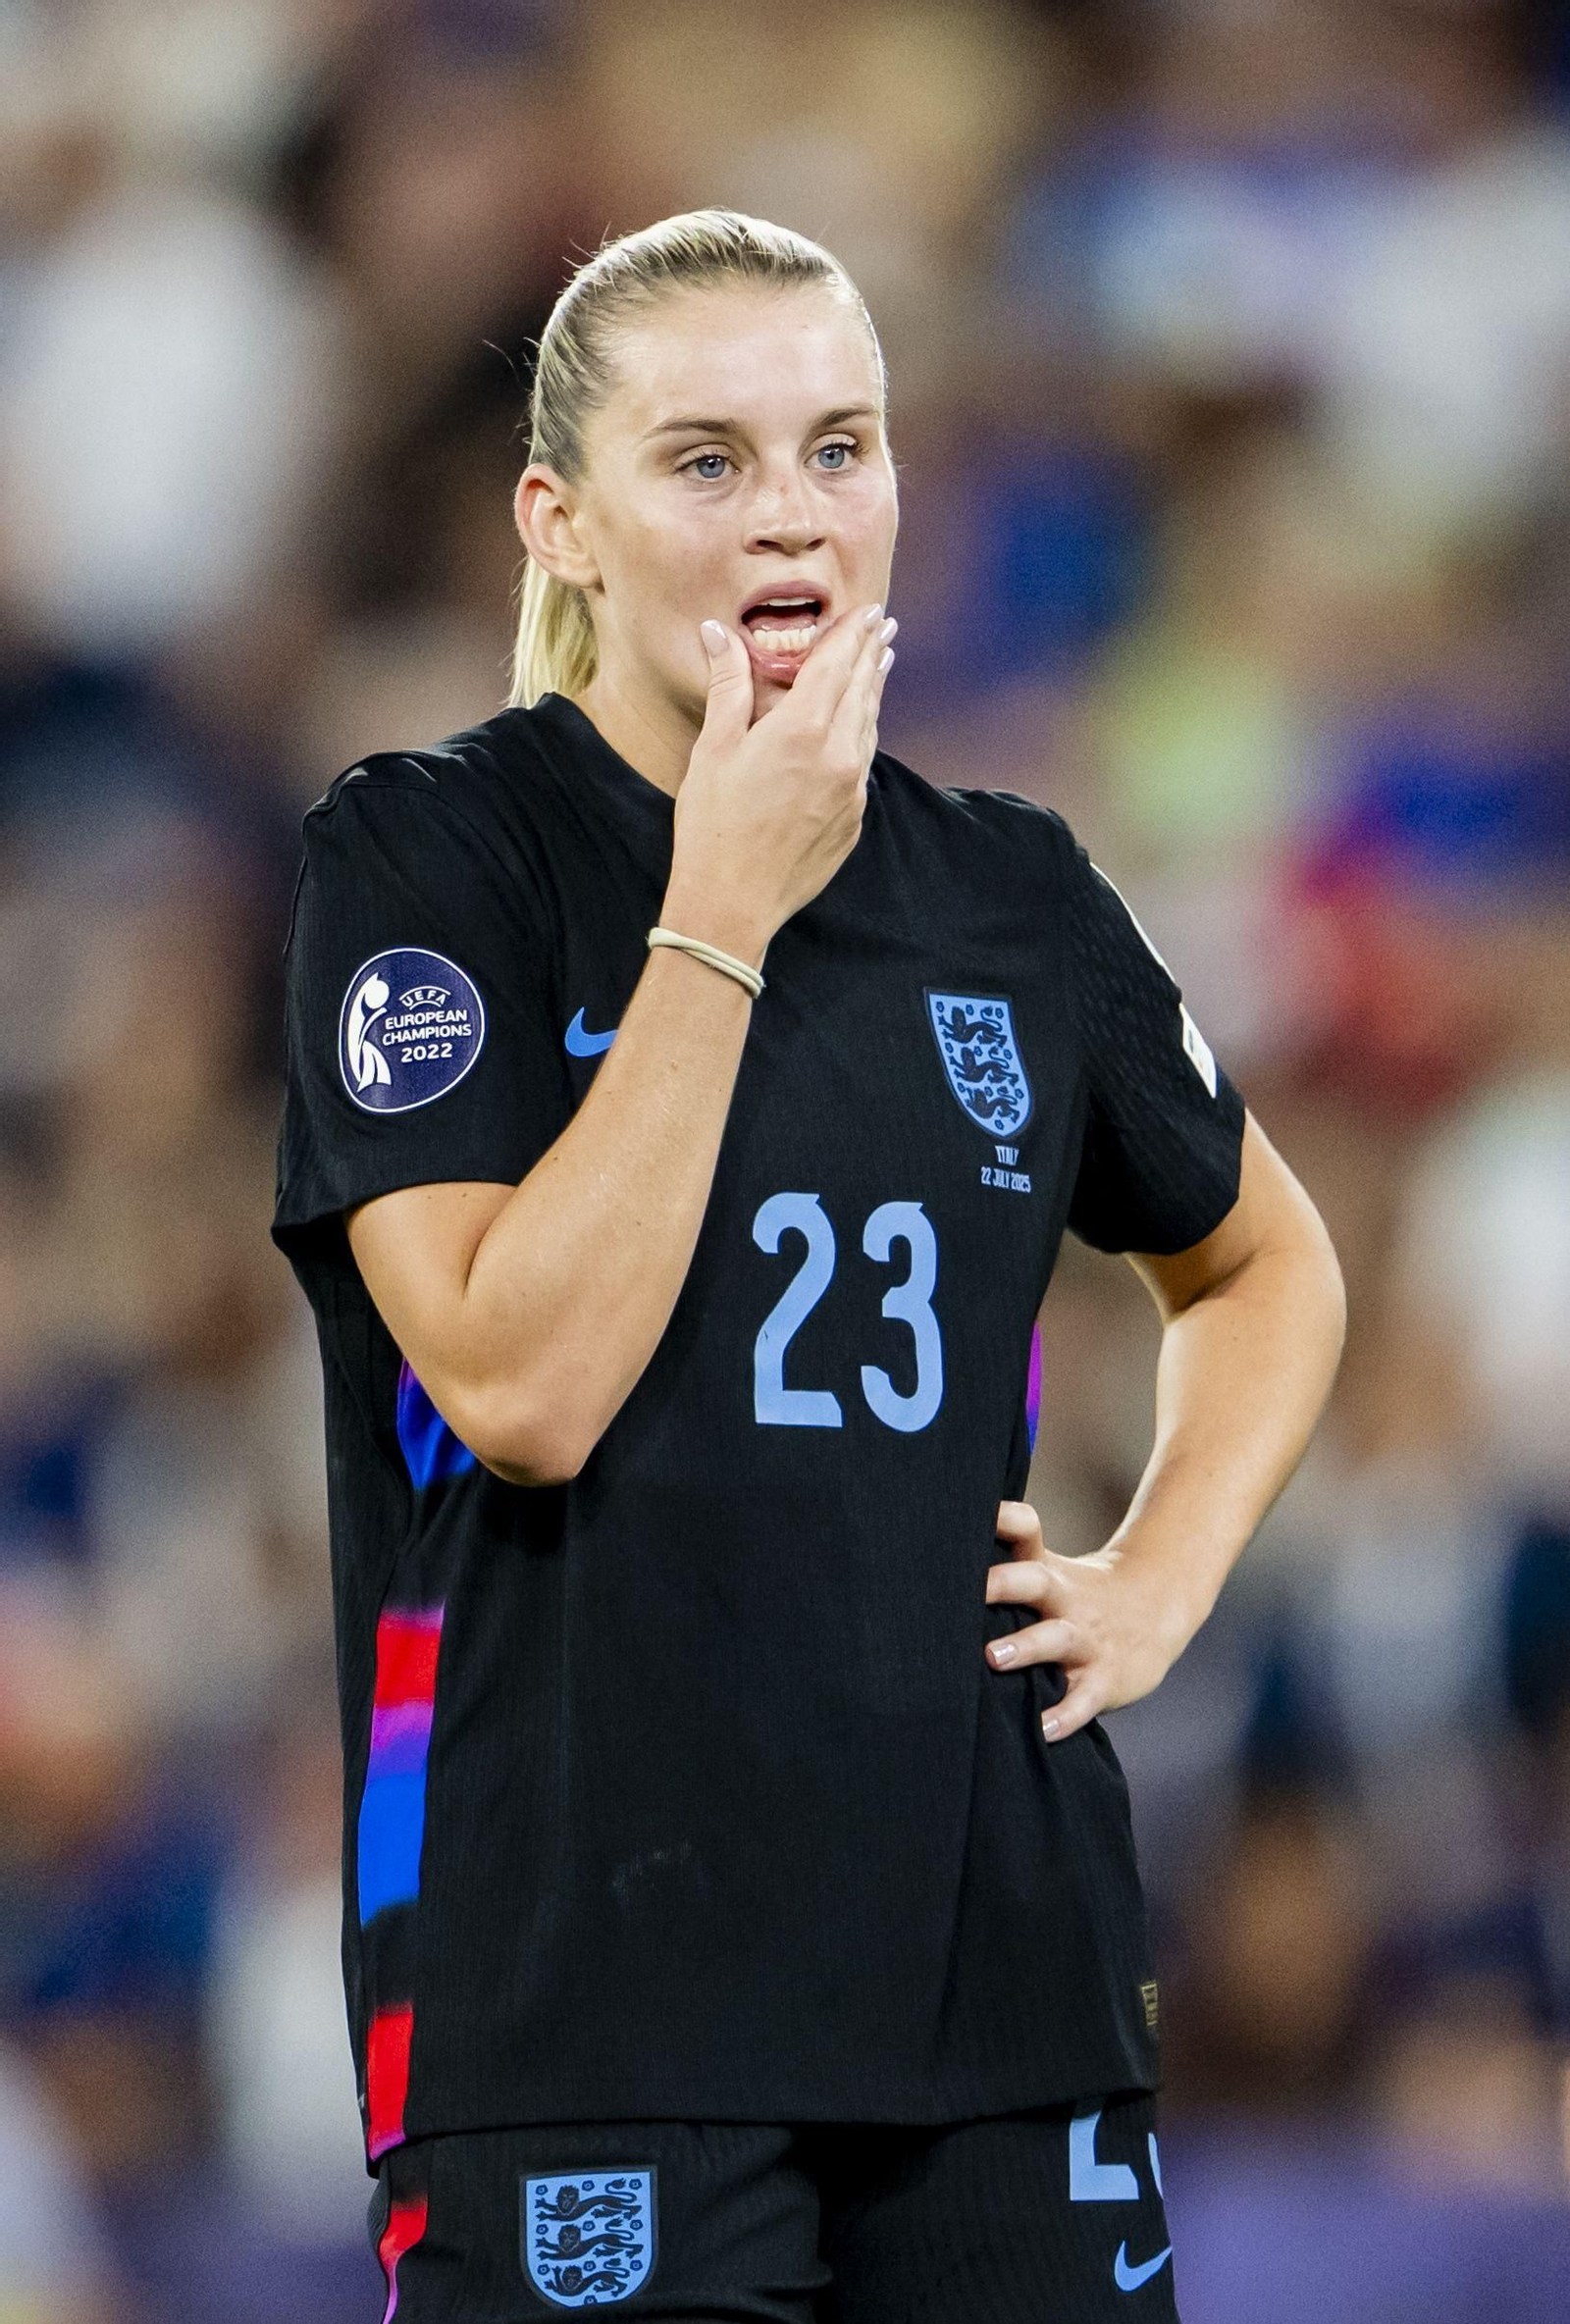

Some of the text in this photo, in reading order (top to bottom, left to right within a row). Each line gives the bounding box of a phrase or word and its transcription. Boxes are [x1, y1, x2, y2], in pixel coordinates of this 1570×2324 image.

[401, 989, 446, 1007] UEFA
[385, 1008, 468, 1030] EUROPEAN
[383, 1023, 472, 1047] CHAMPIONS
[400, 1042, 453, 1063] 2022
[995, 1145, 1020, 1166] ITALY
[981, 1165, 1031, 1193] 22 JULY 2025
[753, 1191, 943, 1432] 23
